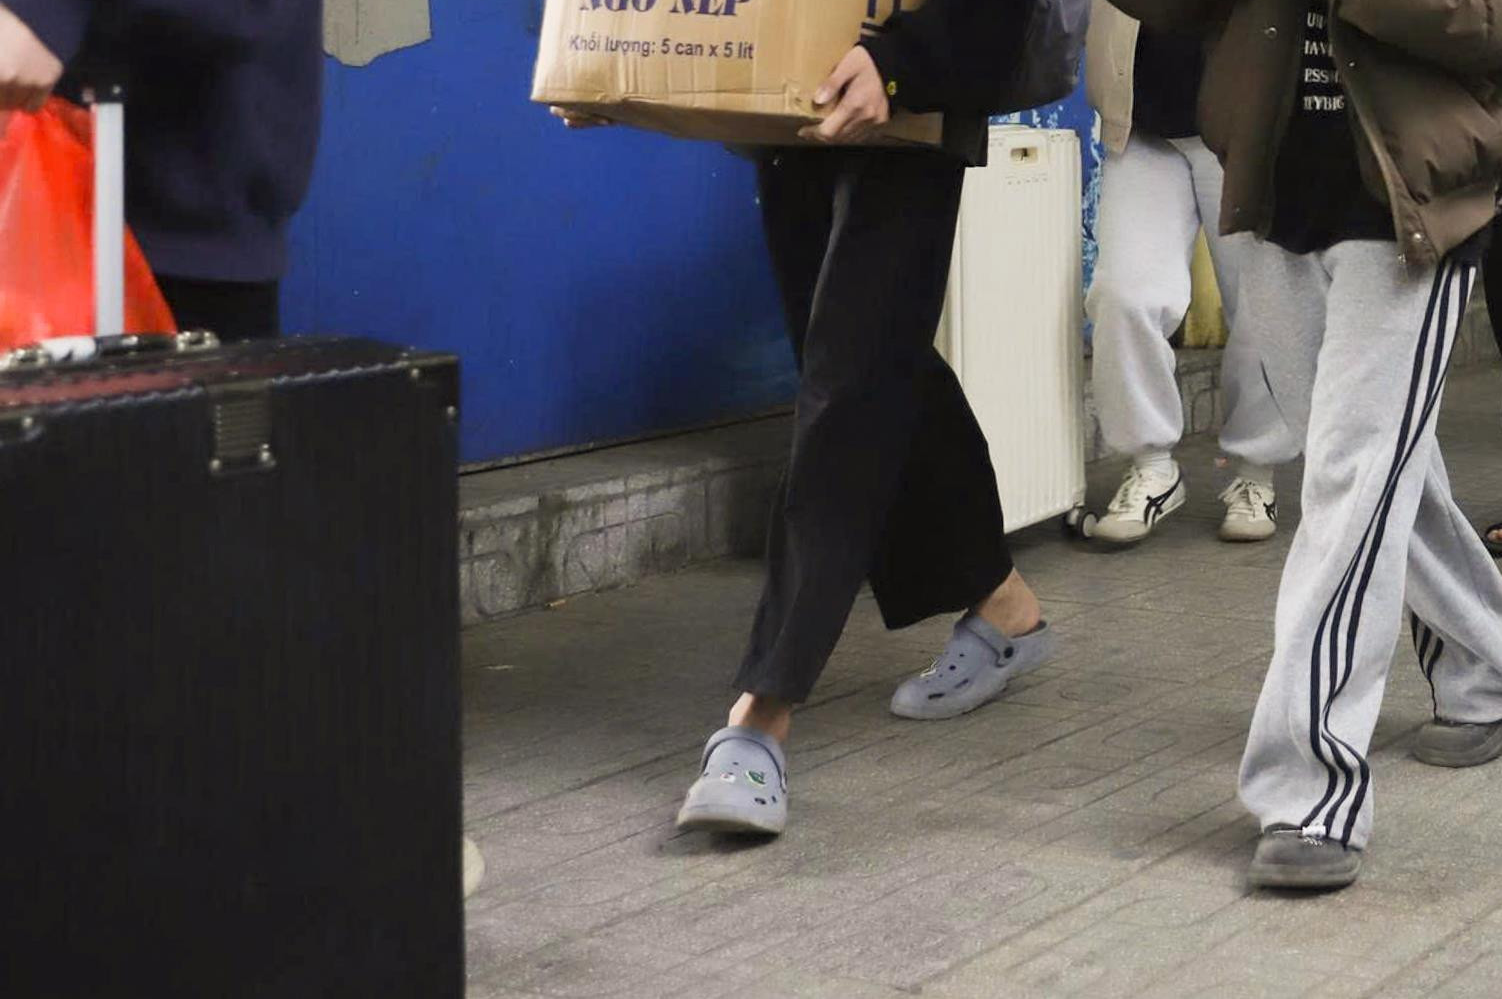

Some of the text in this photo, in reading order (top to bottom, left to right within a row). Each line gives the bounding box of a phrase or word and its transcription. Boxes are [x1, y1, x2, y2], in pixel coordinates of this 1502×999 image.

[604, 36, 656, 57] lượng:
[660, 38, 671, 54] 5
[674, 42, 704, 56] can
[708, 44, 718, 57] x
[723, 41, 733, 58] 5
